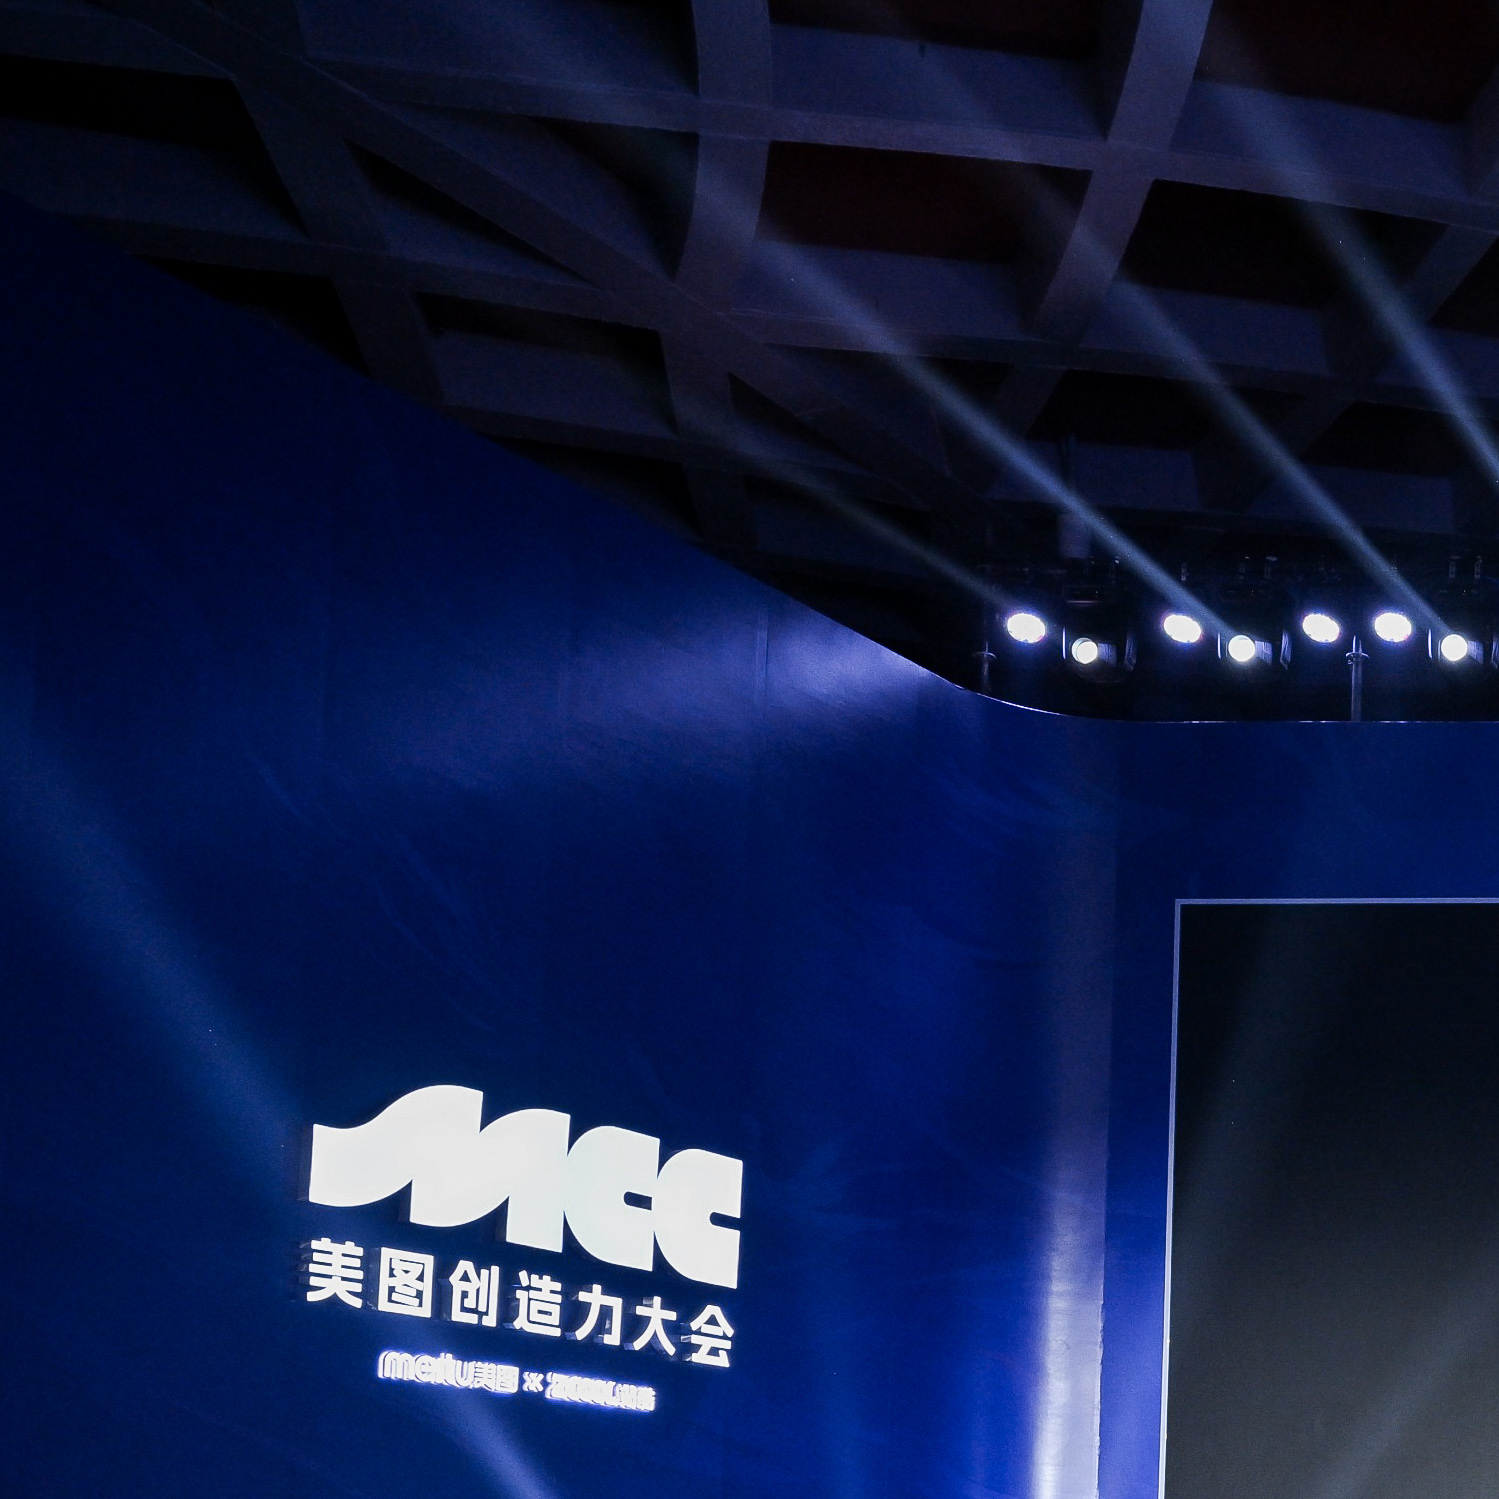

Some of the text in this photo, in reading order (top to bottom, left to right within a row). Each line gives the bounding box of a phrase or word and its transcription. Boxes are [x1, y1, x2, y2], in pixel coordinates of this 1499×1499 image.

[307, 1238, 734, 1367] 美图创造力大会
